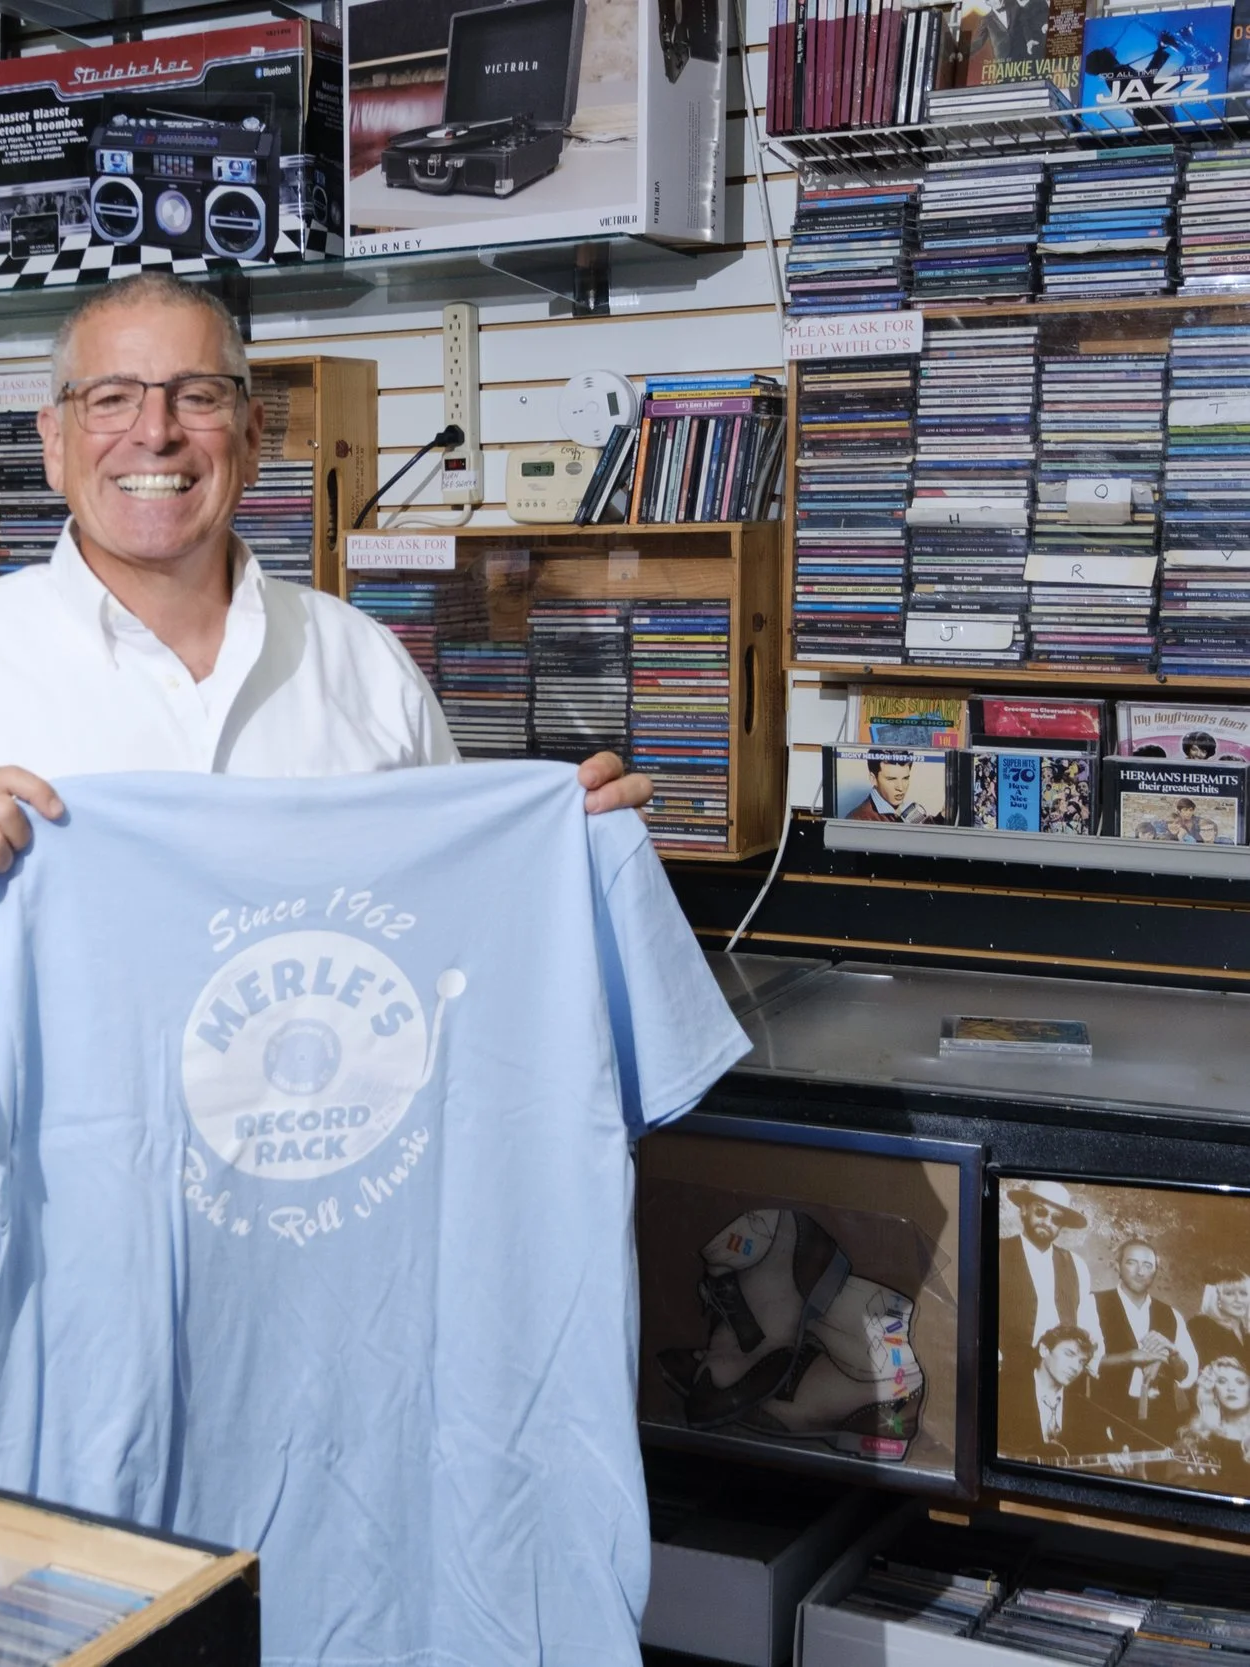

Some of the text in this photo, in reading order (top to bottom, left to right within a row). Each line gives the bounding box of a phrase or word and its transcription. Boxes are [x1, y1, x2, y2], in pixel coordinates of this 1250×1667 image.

[68, 57, 193, 86] Studebaker
[484, 60, 539, 75] VICTROLA
[981, 60, 1032, 81] FRANKIE
[1035, 57, 1069, 75] VALLI
[1071, 56, 1081, 71] &
[1116, 71, 1133, 79] ALL
[1096, 73, 1210, 103] JAZZ
[33, 107, 70, 120] Blaster
[35, 118, 84, 132] Boombox
[599, 214, 638, 229] VICTROLA
[350, 239, 423, 257] JOURNEY
[789, 319, 915, 339] PLEASE ASK FOR
[789, 337, 912, 357] HELP WITH CD'S
[29, 380, 48, 390] ASK
[18, 393, 44, 404] WITH
[949, 513, 960, 525] H
[351, 539, 447, 550] PLEASE ASK FOR
[351, 555, 446, 566] HELP WITH CD'S
[1071, 563, 1085, 579] R
[863, 697, 961, 730] TIMES SQUARE
[1040, 707, 1077, 715] Clearwater
[1154, 712, 1216, 725] Boyfriend's
[1219, 716, 1248, 731] Back
[1003, 758, 1036, 770] SUPER HITS
[1120, 770, 1239, 785] HERMAN'S HERMITS
[1009, 782, 1030, 790] Have
[1138, 781, 1219, 794] their greatest hits
[1010, 802, 1028, 810] Day
[208, 886, 416, 952] Since 1962
[195, 956, 414, 1055] MERLE'S
[234, 1104, 371, 1140] RECORD
[254, 1134, 348, 1166] RACK
[183, 1145, 231, 1228] Rock
[268, 1196, 345, 1248] Roll
[353, 1126, 429, 1219] Music
